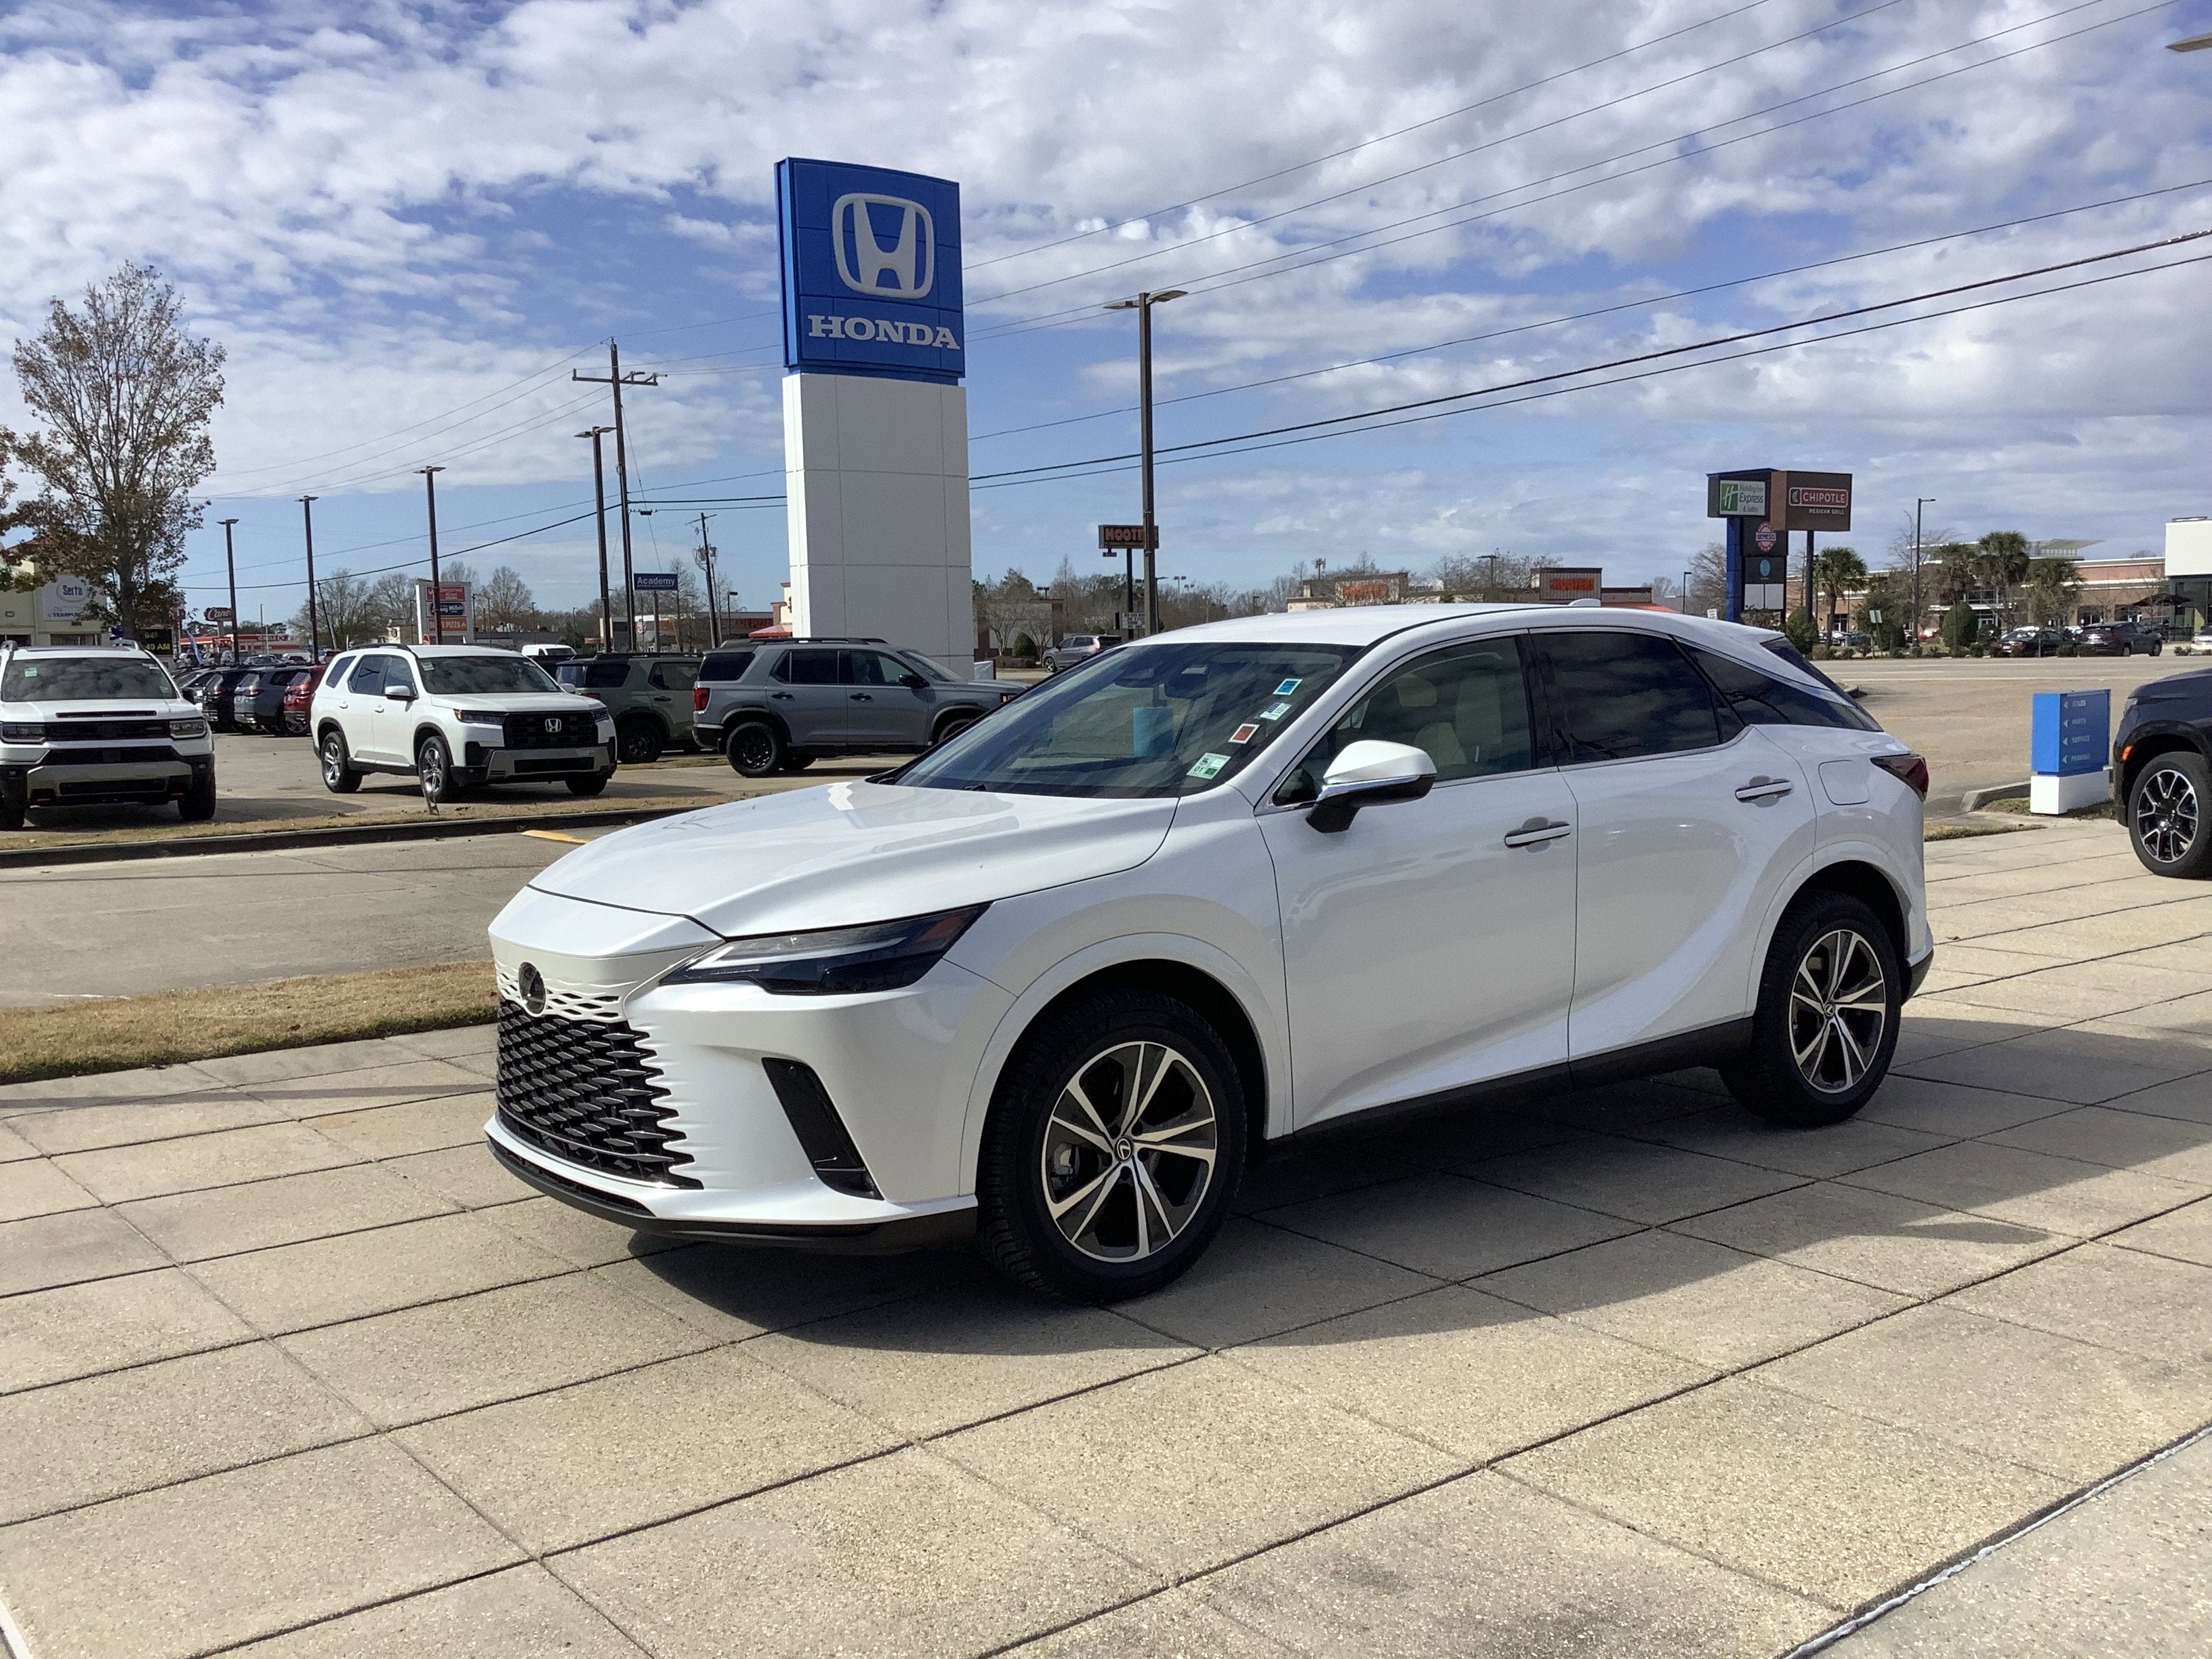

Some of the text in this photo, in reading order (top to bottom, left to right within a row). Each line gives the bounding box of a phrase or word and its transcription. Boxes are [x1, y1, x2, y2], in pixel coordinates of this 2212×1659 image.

[807, 314, 960, 350] HONDA
[1739, 492, 1763, 505] Express
[1803, 492, 1846, 504] CHIPOTLE
[636, 576, 676, 587] Academy
[62, 584, 83, 596] Serta
[157, 642, 171, 651] AM
